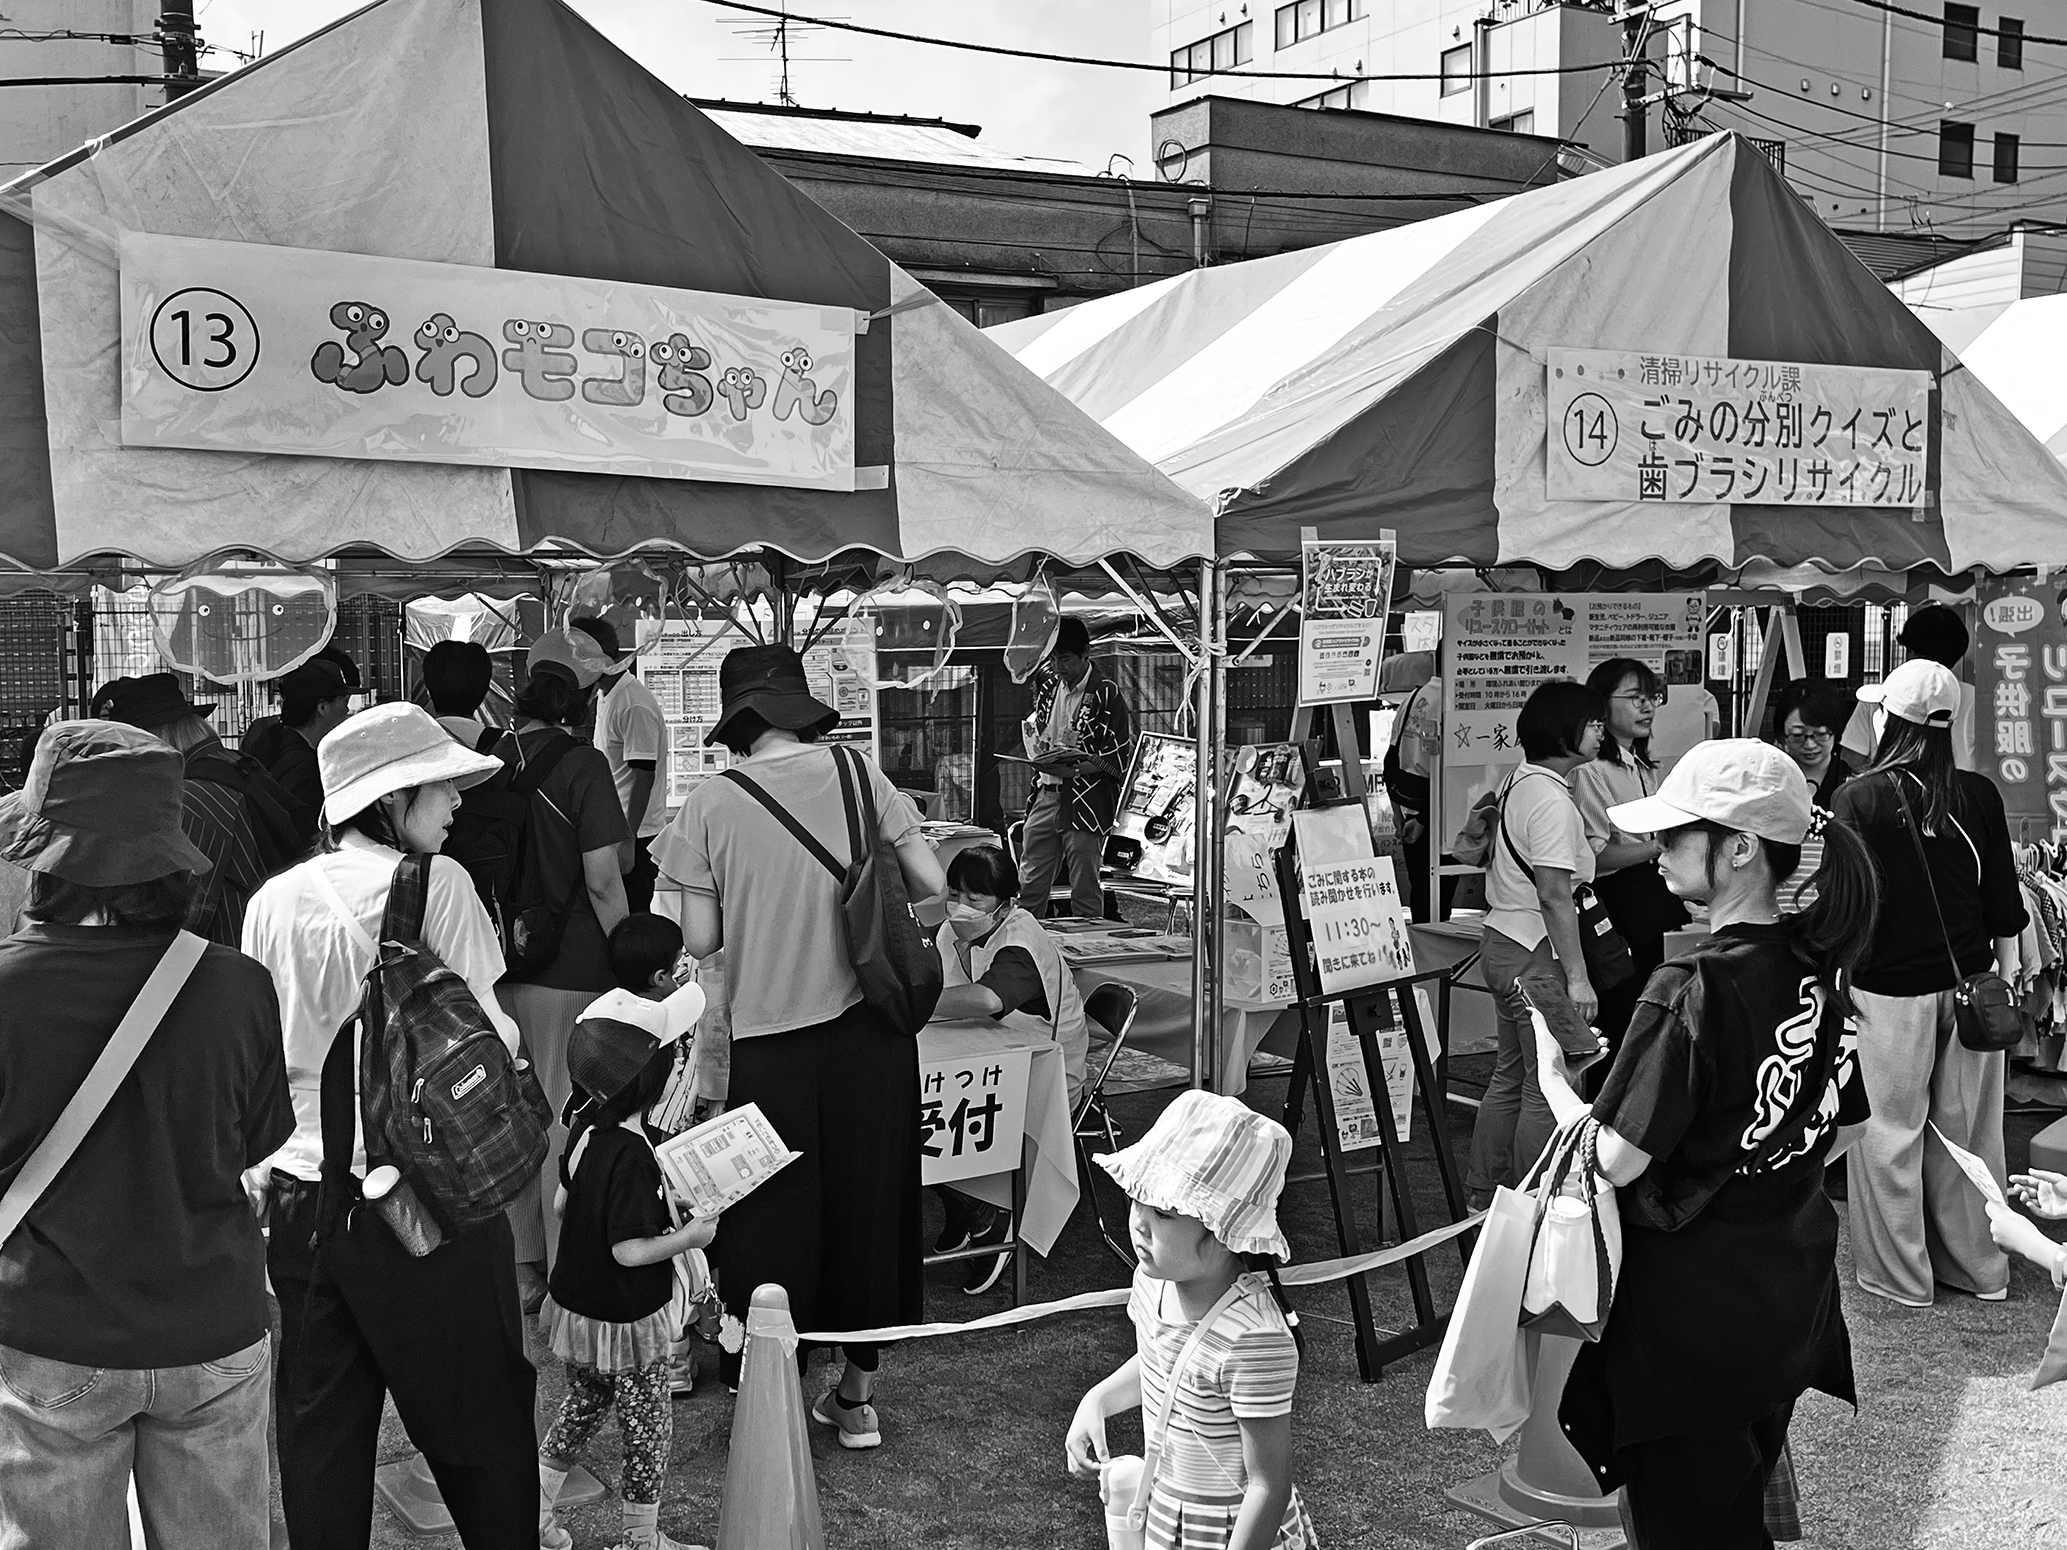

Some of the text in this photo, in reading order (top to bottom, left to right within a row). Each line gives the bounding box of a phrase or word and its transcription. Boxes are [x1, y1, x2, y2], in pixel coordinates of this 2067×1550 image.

[169, 308, 237, 370] 13
[310, 300, 839, 427] ふわモコちゃん
[1639, 355, 1802, 394] 清掃リサイクル課
[1759, 390, 1793, 403] ぶんべつ
[1573, 408, 1608, 450] 14
[1639, 394, 1923, 453] ごみの分別クイズと
[1637, 451, 1922, 505] 歯ブラシリサイクル
[1324, 567, 1375, 581] ハブラシが
[1324, 582, 1372, 593] 生まれ変わる
[1470, 600, 1546, 618] 子供服の
[1465, 618, 1550, 635] リユースクローゼット
[1557, 625, 1573, 635] とは
[1458, 691, 1482, 700] 受付時間
[1484, 700, 1527, 710] 火曜日から日曜
[1475, 723, 1521, 752] 一家
[1307, 866, 1376, 889] ごみに関する本の
[1309, 881, 1396, 907] 読み聞かせを行います。
